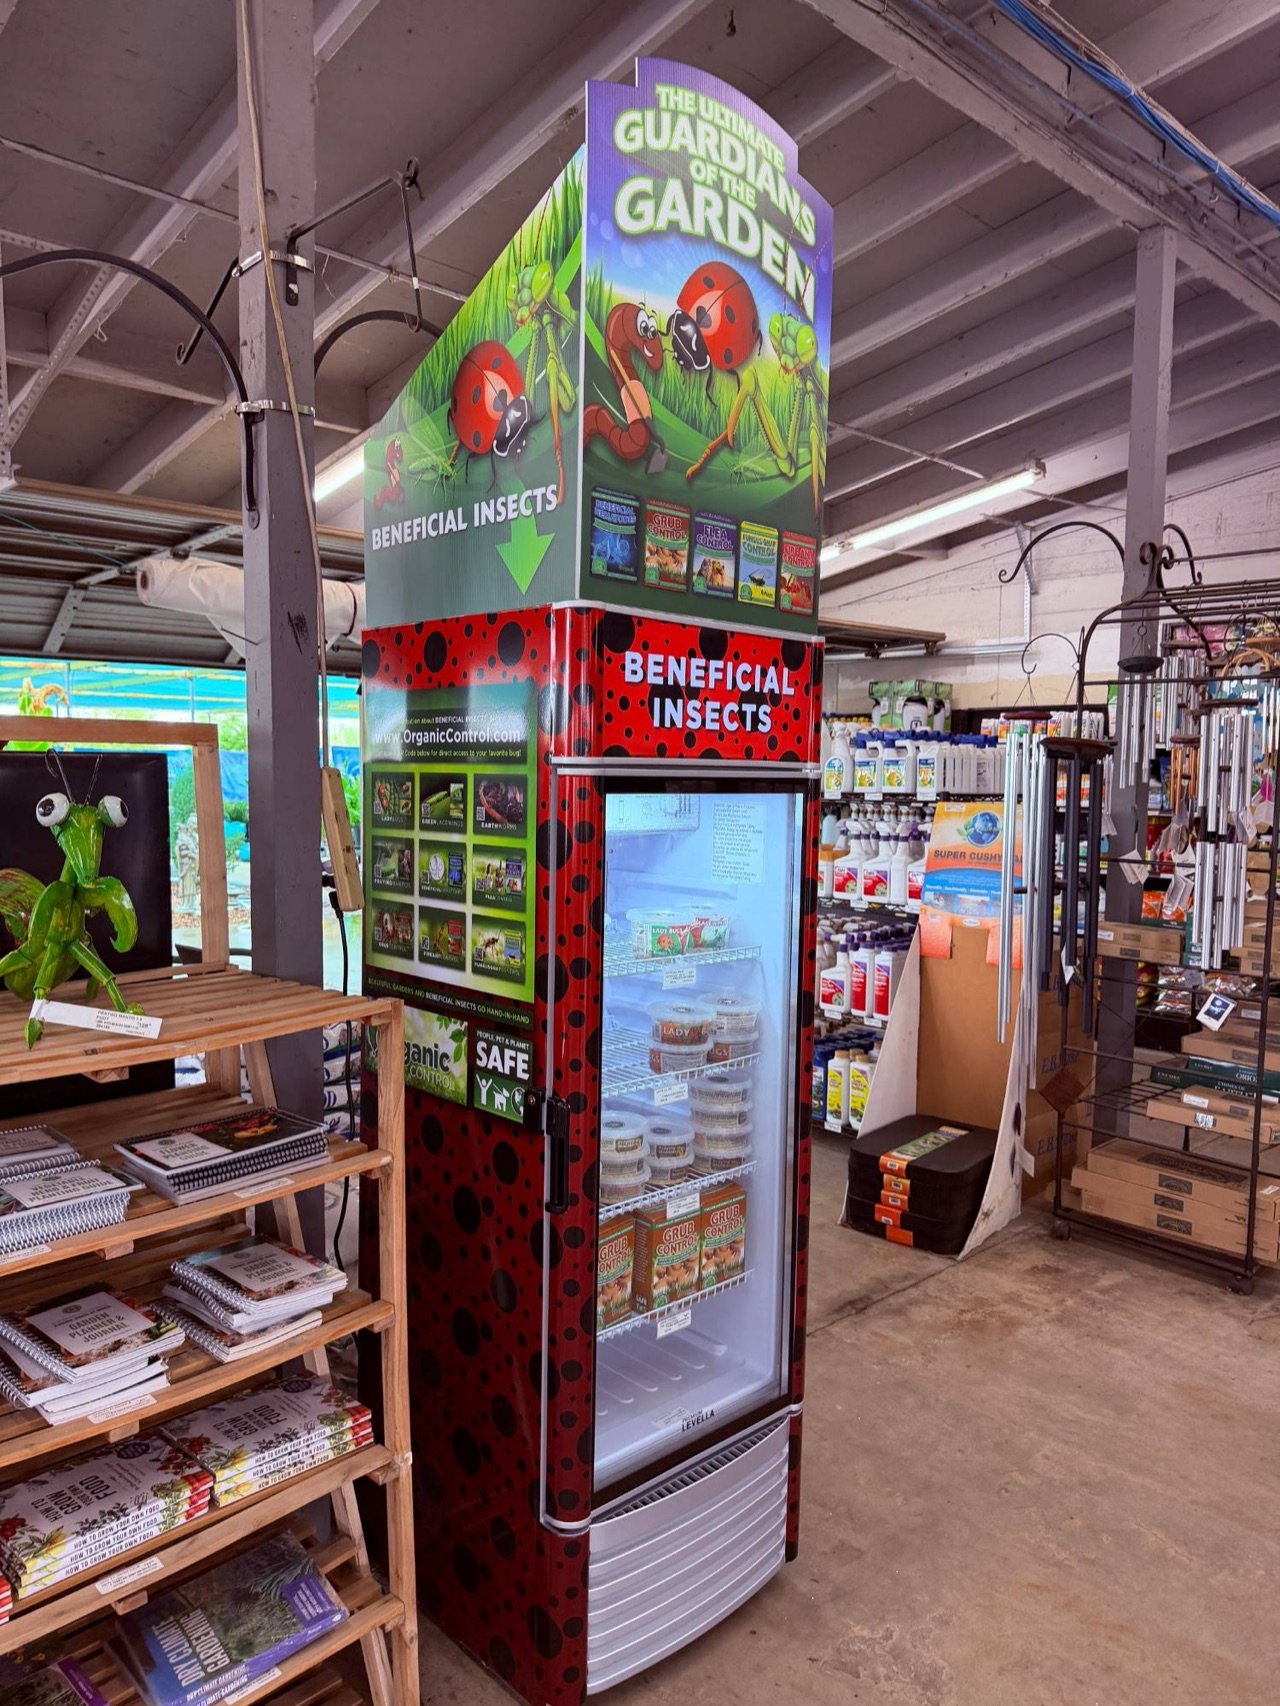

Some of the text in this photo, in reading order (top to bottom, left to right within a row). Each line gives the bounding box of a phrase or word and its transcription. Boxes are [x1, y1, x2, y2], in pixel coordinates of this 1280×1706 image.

[656, 83, 785, 172] THE ULTIMATE
[613, 108, 816, 247] GUARDIANS
[689, 157, 756, 211] OF THE
[614, 175, 815, 322] GARDEN
[371, 483, 558, 551] BENEFICIAL INSECTS
[653, 514, 681, 529] GRUB
[647, 524, 687, 539] CONTROL
[696, 534, 733, 550] CONTROL
[703, 525, 728, 540] FLEA
[742, 543, 776, 556] CONTROL
[624, 651, 795, 696] BENEFICIAL
[435, 715, 465, 724] BENEFICIAL
[653, 697, 772, 733] INSECTS
[375, 727, 521, 746] www.OrganicControl.com
[469, 749, 475, 757] to
[509, 749, 521, 758] bug!
[933, 850, 1002, 862] SUPER CUSHY
[392, 982, 414, 995] GARDENS
[415, 989, 425, 998] AND
[426, 992, 454, 1005] BENEFICIAL
[455, 999, 477, 1011] INSECTS
[487, 1008, 530, 1024] HAND-IN-HAND
[495, 1036, 504, 1044] PET
[510, 1039, 530, 1051] PLANET
[663, 1027, 690, 1037] LADY
[404, 1040, 451, 1073] ganic
[476, 1040, 530, 1081] SAFE
[409, 1064, 455, 1092] CONTROL
[1236, 1072, 1258, 1081] ORIO
[29, 1187, 81, 1202] PLANTING
[31, 1176, 86, 1191] VEGETABLE
[711, 1204, 740, 1225] GRUB
[662, 1221, 695, 1242] GRUB
[705, 1218, 744, 1239] CONTROL
[599, 1236, 628, 1261] GRUB
[657, 1233, 698, 1256] CONTROL
[245, 1265, 283, 1279] PLANNER
[599, 1248, 632, 1273] ONTROL
[259, 1267, 297, 1282] JOURNAL
[69, 1312, 110, 1330] GARDEN
[69, 1319, 114, 1339] PLANNER
[83, 1323, 129, 1342] JOURNAL
[226, 1416, 258, 1436] GROW
[252, 1405, 287, 1425] FOOD
[682, 1409, 715, 1433] LEVELLA
[221, 1430, 242, 1442] HOW
[253, 1468, 264, 1477] HOW
[273, 1459, 287, 1469] GROW
[288, 1453, 301, 1463] YOUR
[301, 1448, 313, 1457] OWN
[313, 1443, 326, 1453] FOOD
[254, 1455, 267, 1463] HOW
[274, 1445, 288, 1456] GROW
[289, 1439, 302, 1449] YOUR
[303, 1435, 314, 1444] OWN
[258, 1481, 270, 1489] HOW
[278, 1471, 291, 1482] GROW
[293, 1466, 305, 1476] YOUR
[305, 1461, 317, 1470] OWN
[317, 1455, 329, 1464] FOOD
[79, 1475, 117, 1500] FOOD
[30, 1498, 63, 1523] HOW TO
[46, 1490, 82, 1515] GROW
[74, 1504, 160, 1549] HOW TO GROW YOUR OWN FOOD
[70, 1517, 158, 1562] HOW TO GROW YOUR OWN FOOD
[65, 1565, 79, 1576] HOW
[90, 1552, 107, 1565] GROW
[108, 1544, 123, 1557] YOUR
[124, 1538, 138, 1548] OWN
[139, 1531, 154, 1542] FOOD
[151, 1616, 206, 1688] DRY CLIMATE
[179, 1609, 230, 1673] GARDENING
